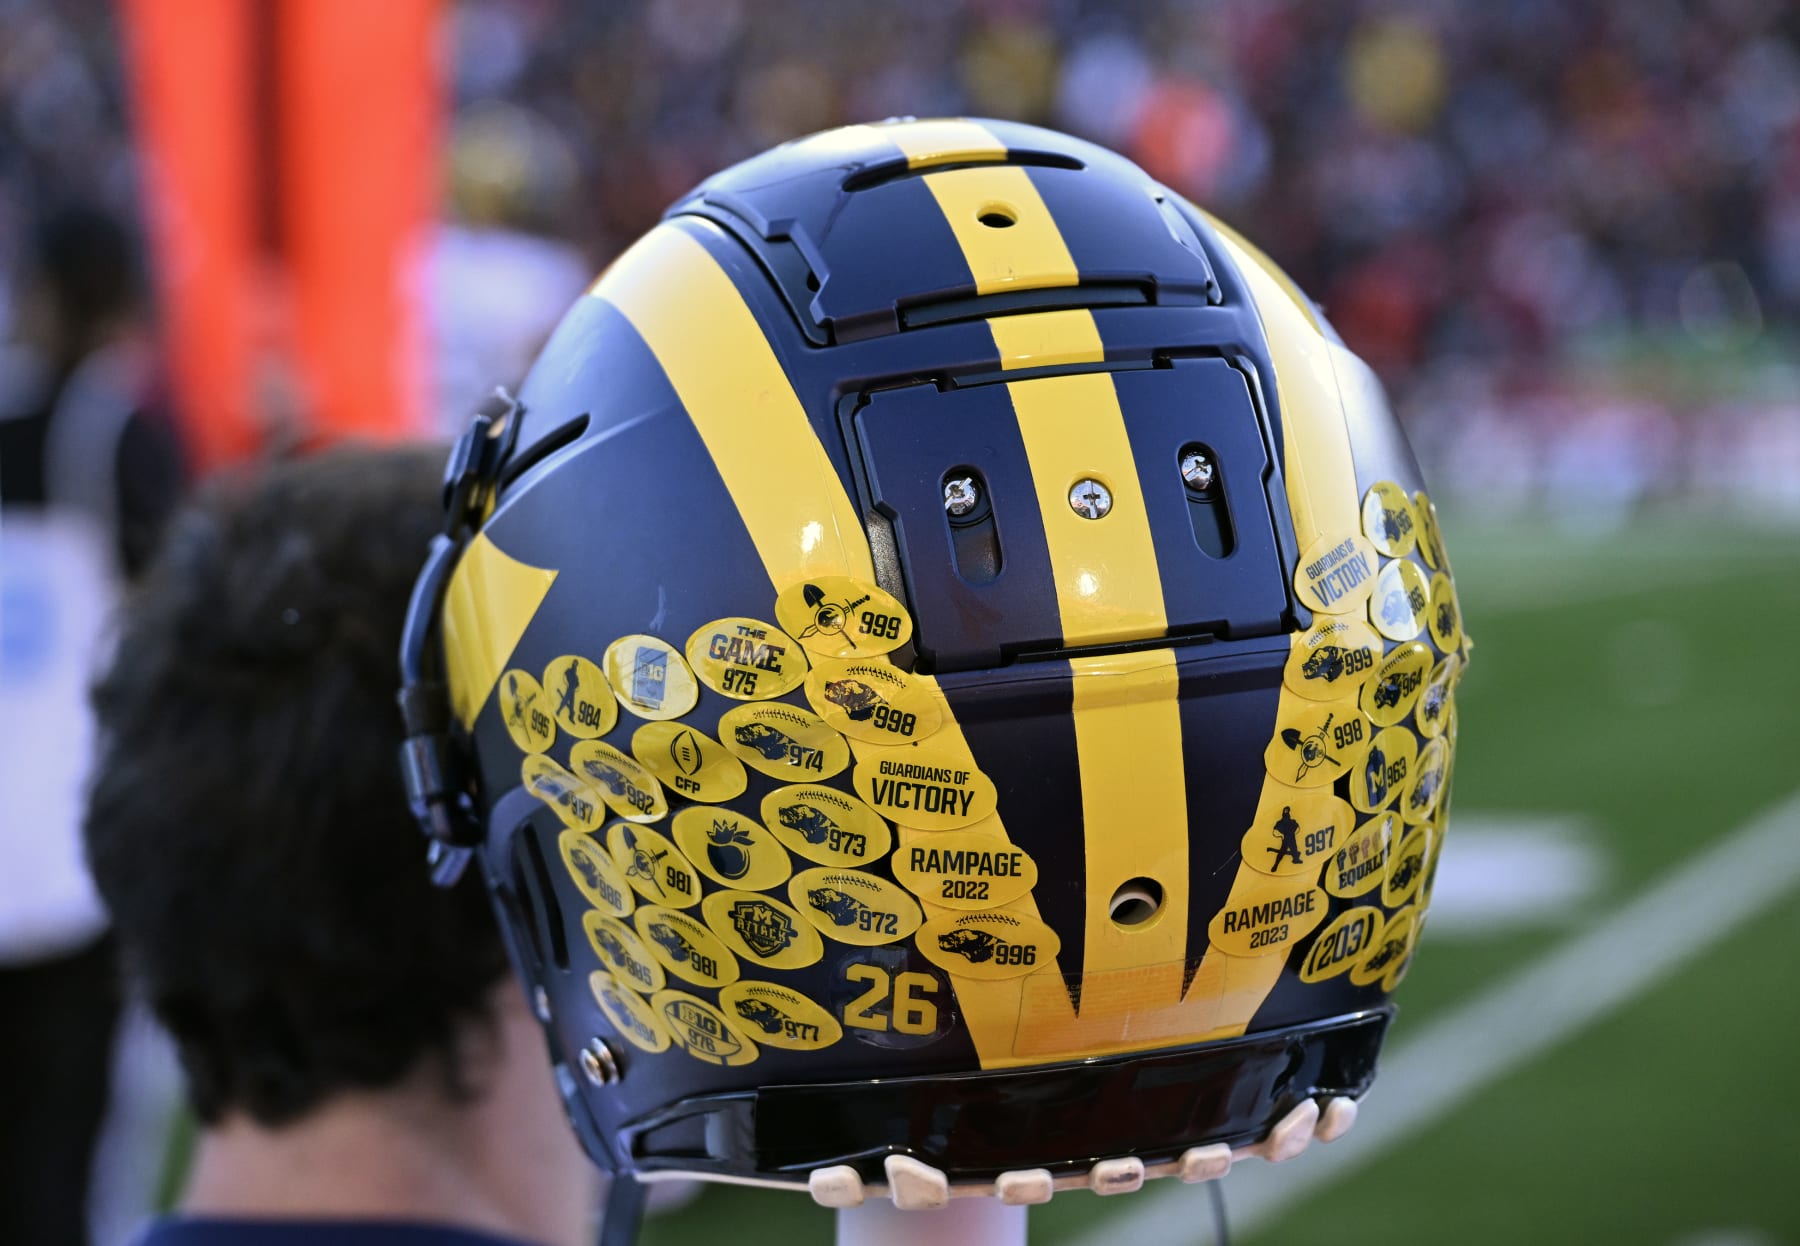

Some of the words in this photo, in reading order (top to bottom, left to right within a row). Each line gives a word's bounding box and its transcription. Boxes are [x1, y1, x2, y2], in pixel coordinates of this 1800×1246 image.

[1306, 543, 1348, 580] GUARDIANS
[1344, 538, 1355, 559] OF
[1310, 552, 1372, 608] VICTORY
[736, 626, 767, 640] THE
[859, 611, 902, 640] 999
[709, 633, 785, 673] GAME
[1344, 645, 1373, 676] 999
[722, 668, 758, 696] 975
[1402, 666, 1423, 697] 964
[531, 708, 549, 739] 995
[578, 701, 601, 731] 984
[873, 706, 917, 737] 998
[1334, 718, 1363, 749] 998
[787, 743, 825, 773] 974
[879, 760, 951, 784] GUARDIANS
[954, 770, 970, 785] OF
[1386, 757, 1407, 789] 963
[625, 783, 655, 816] 982
[675, 775, 701, 794] CFP
[871, 777, 975, 817] VICTORY
[829, 829, 867, 857] 973
[1305, 826, 1335, 856] 997
[910, 847, 1022, 877] RAMPAGE
[666, 866, 691, 895] 981
[942, 880, 989, 900] 2022
[752, 906, 773, 925] M
[859, 909, 898, 935] 972
[1223, 889, 1316, 934] RAMPAGE
[1250, 924, 1289, 950] 2023
[1307, 912, 1374, 976] (203)
[691, 950, 718, 980] 981
[995, 944, 1036, 966] 996
[844, 963, 939, 1036] 26
[688, 1026, 717, 1053] 976
[785, 1021, 819, 1042] 977
